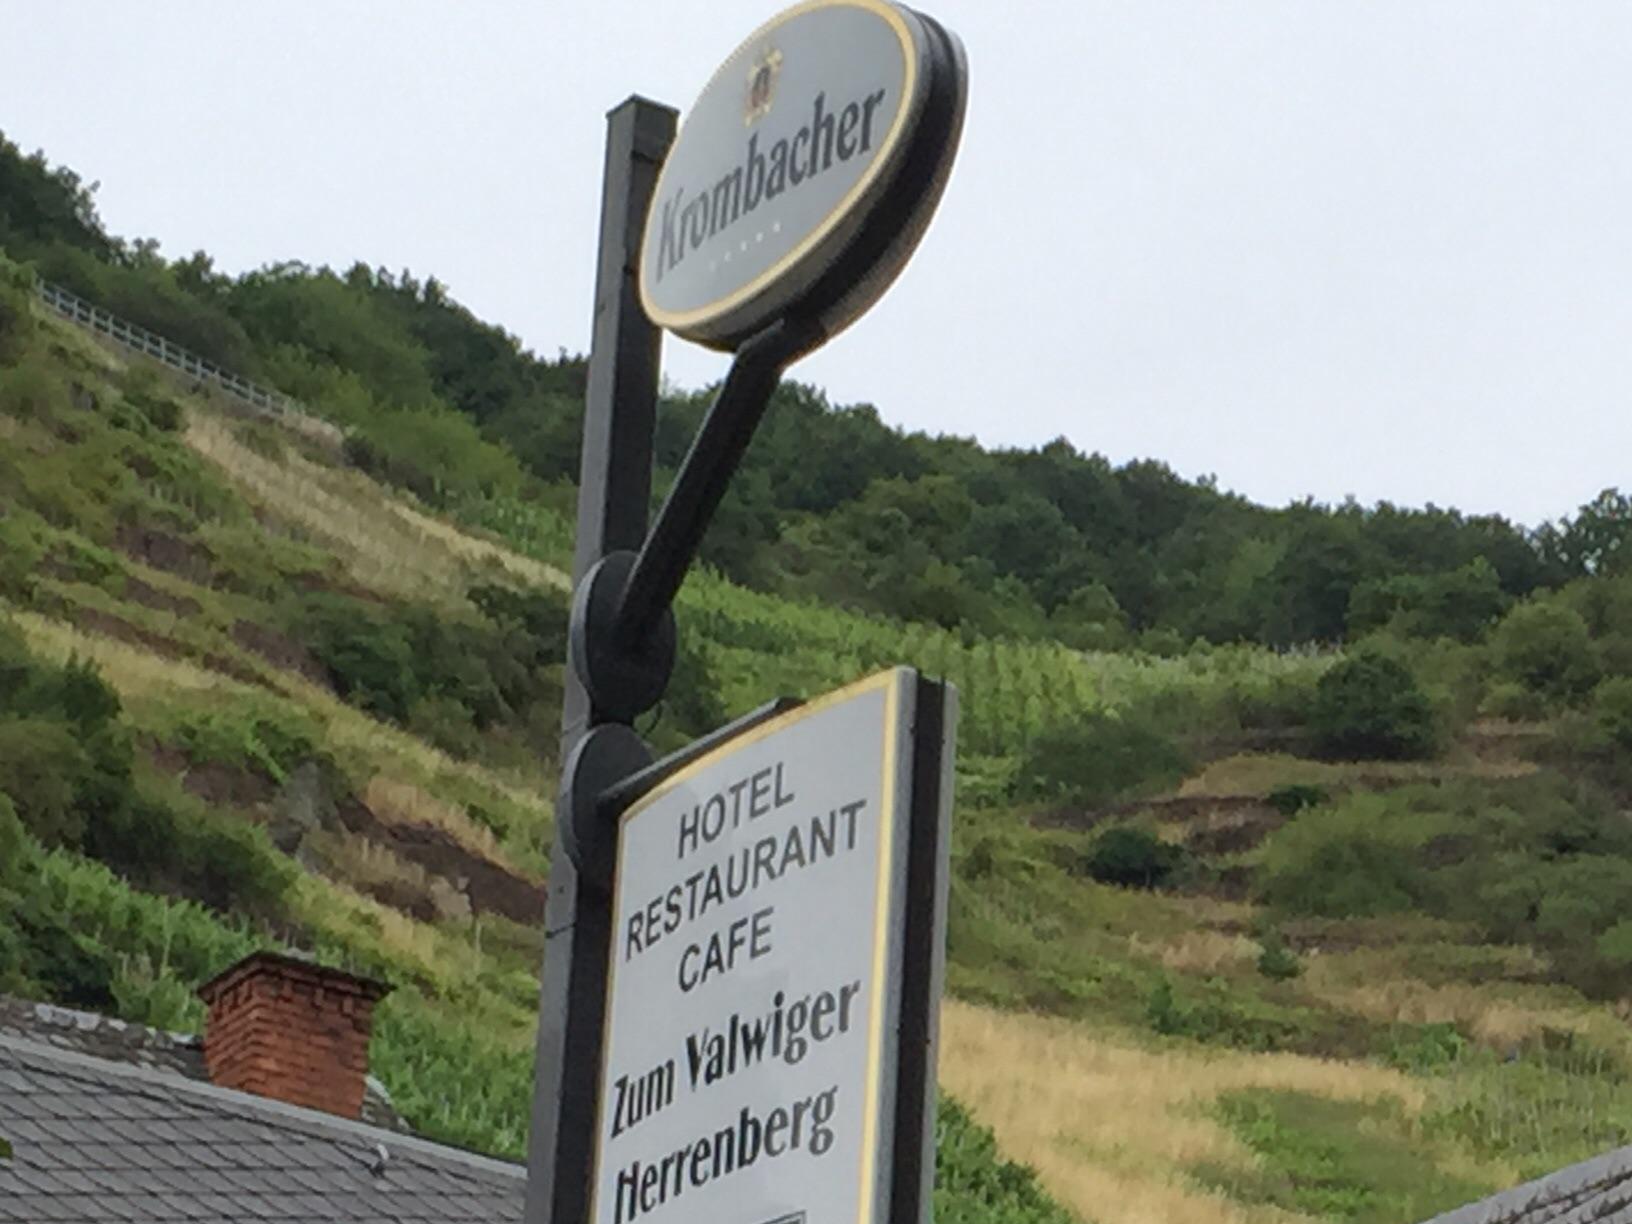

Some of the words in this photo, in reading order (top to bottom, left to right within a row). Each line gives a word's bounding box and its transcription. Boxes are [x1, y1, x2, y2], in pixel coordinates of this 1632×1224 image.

[656, 88, 886, 283] Krombacher
[625, 799, 867, 962] RESTAURANT
[678, 761, 796, 859] HOTEL
[678, 906, 774, 993] CAFE
[610, 1058, 675, 1138] Zum
[686, 980, 860, 1091] Valwiger
